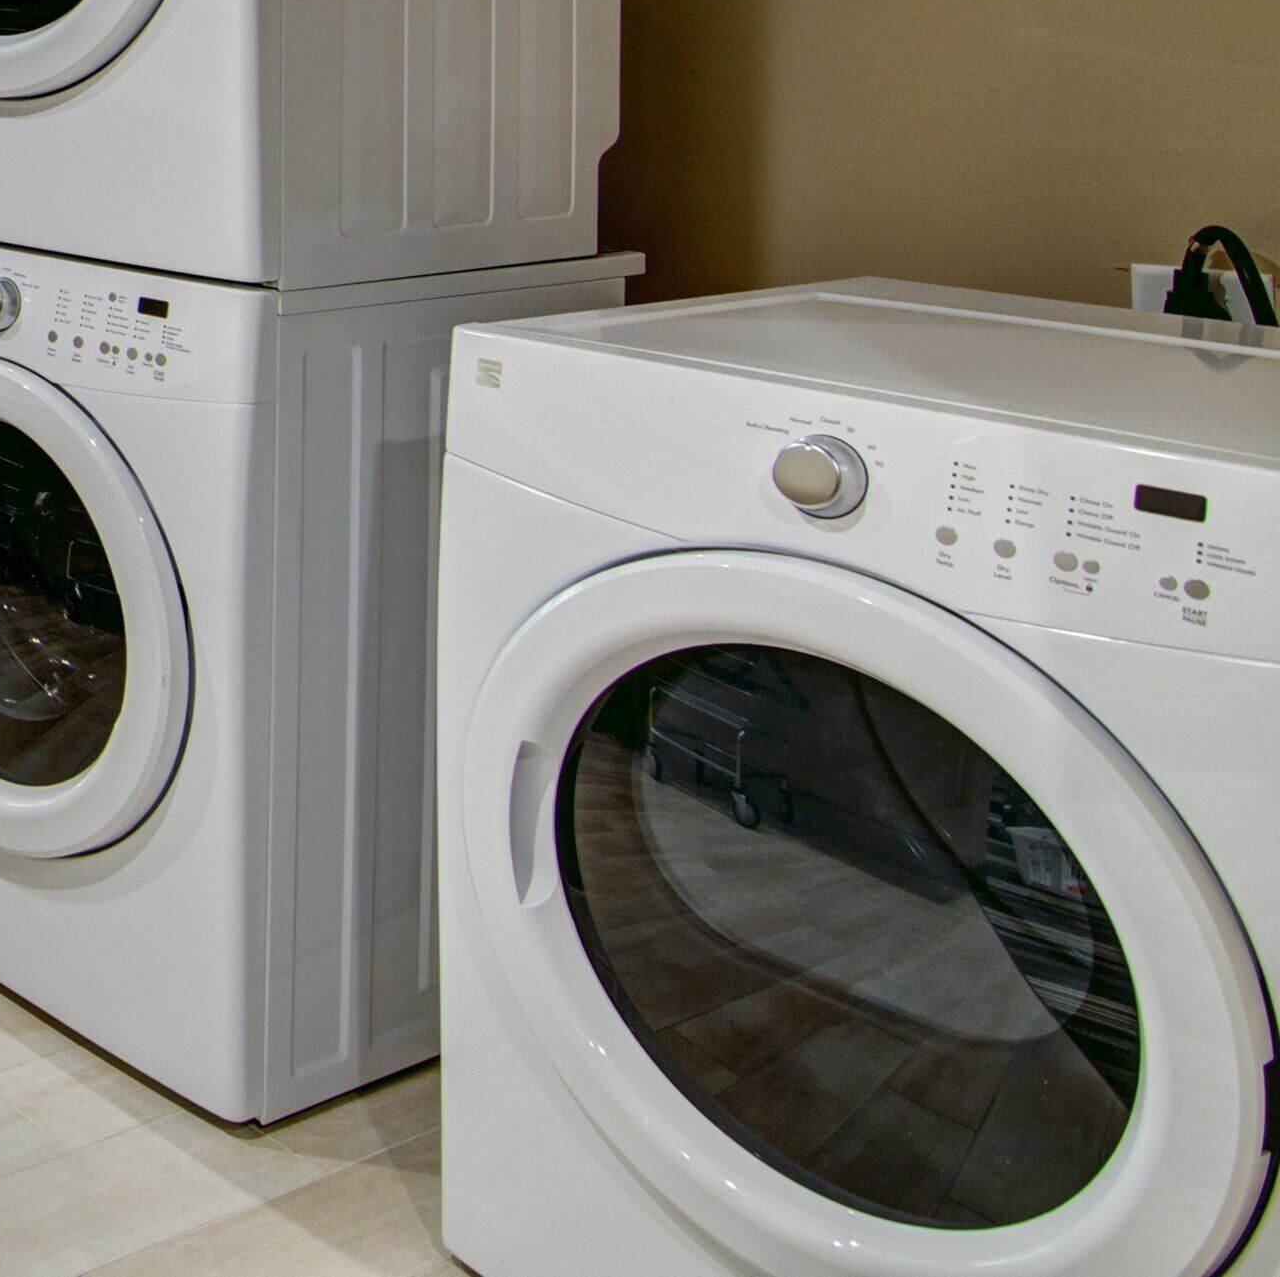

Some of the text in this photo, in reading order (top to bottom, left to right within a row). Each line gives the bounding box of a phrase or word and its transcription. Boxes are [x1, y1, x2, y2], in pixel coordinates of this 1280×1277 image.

[938, 550, 952, 560] Dry
[996, 563, 1011, 573] Dry
[1048, 575, 1080, 589] Options
[1181, 605, 1209, 618] START
[1181, 614, 1208, 628] PAUSE
